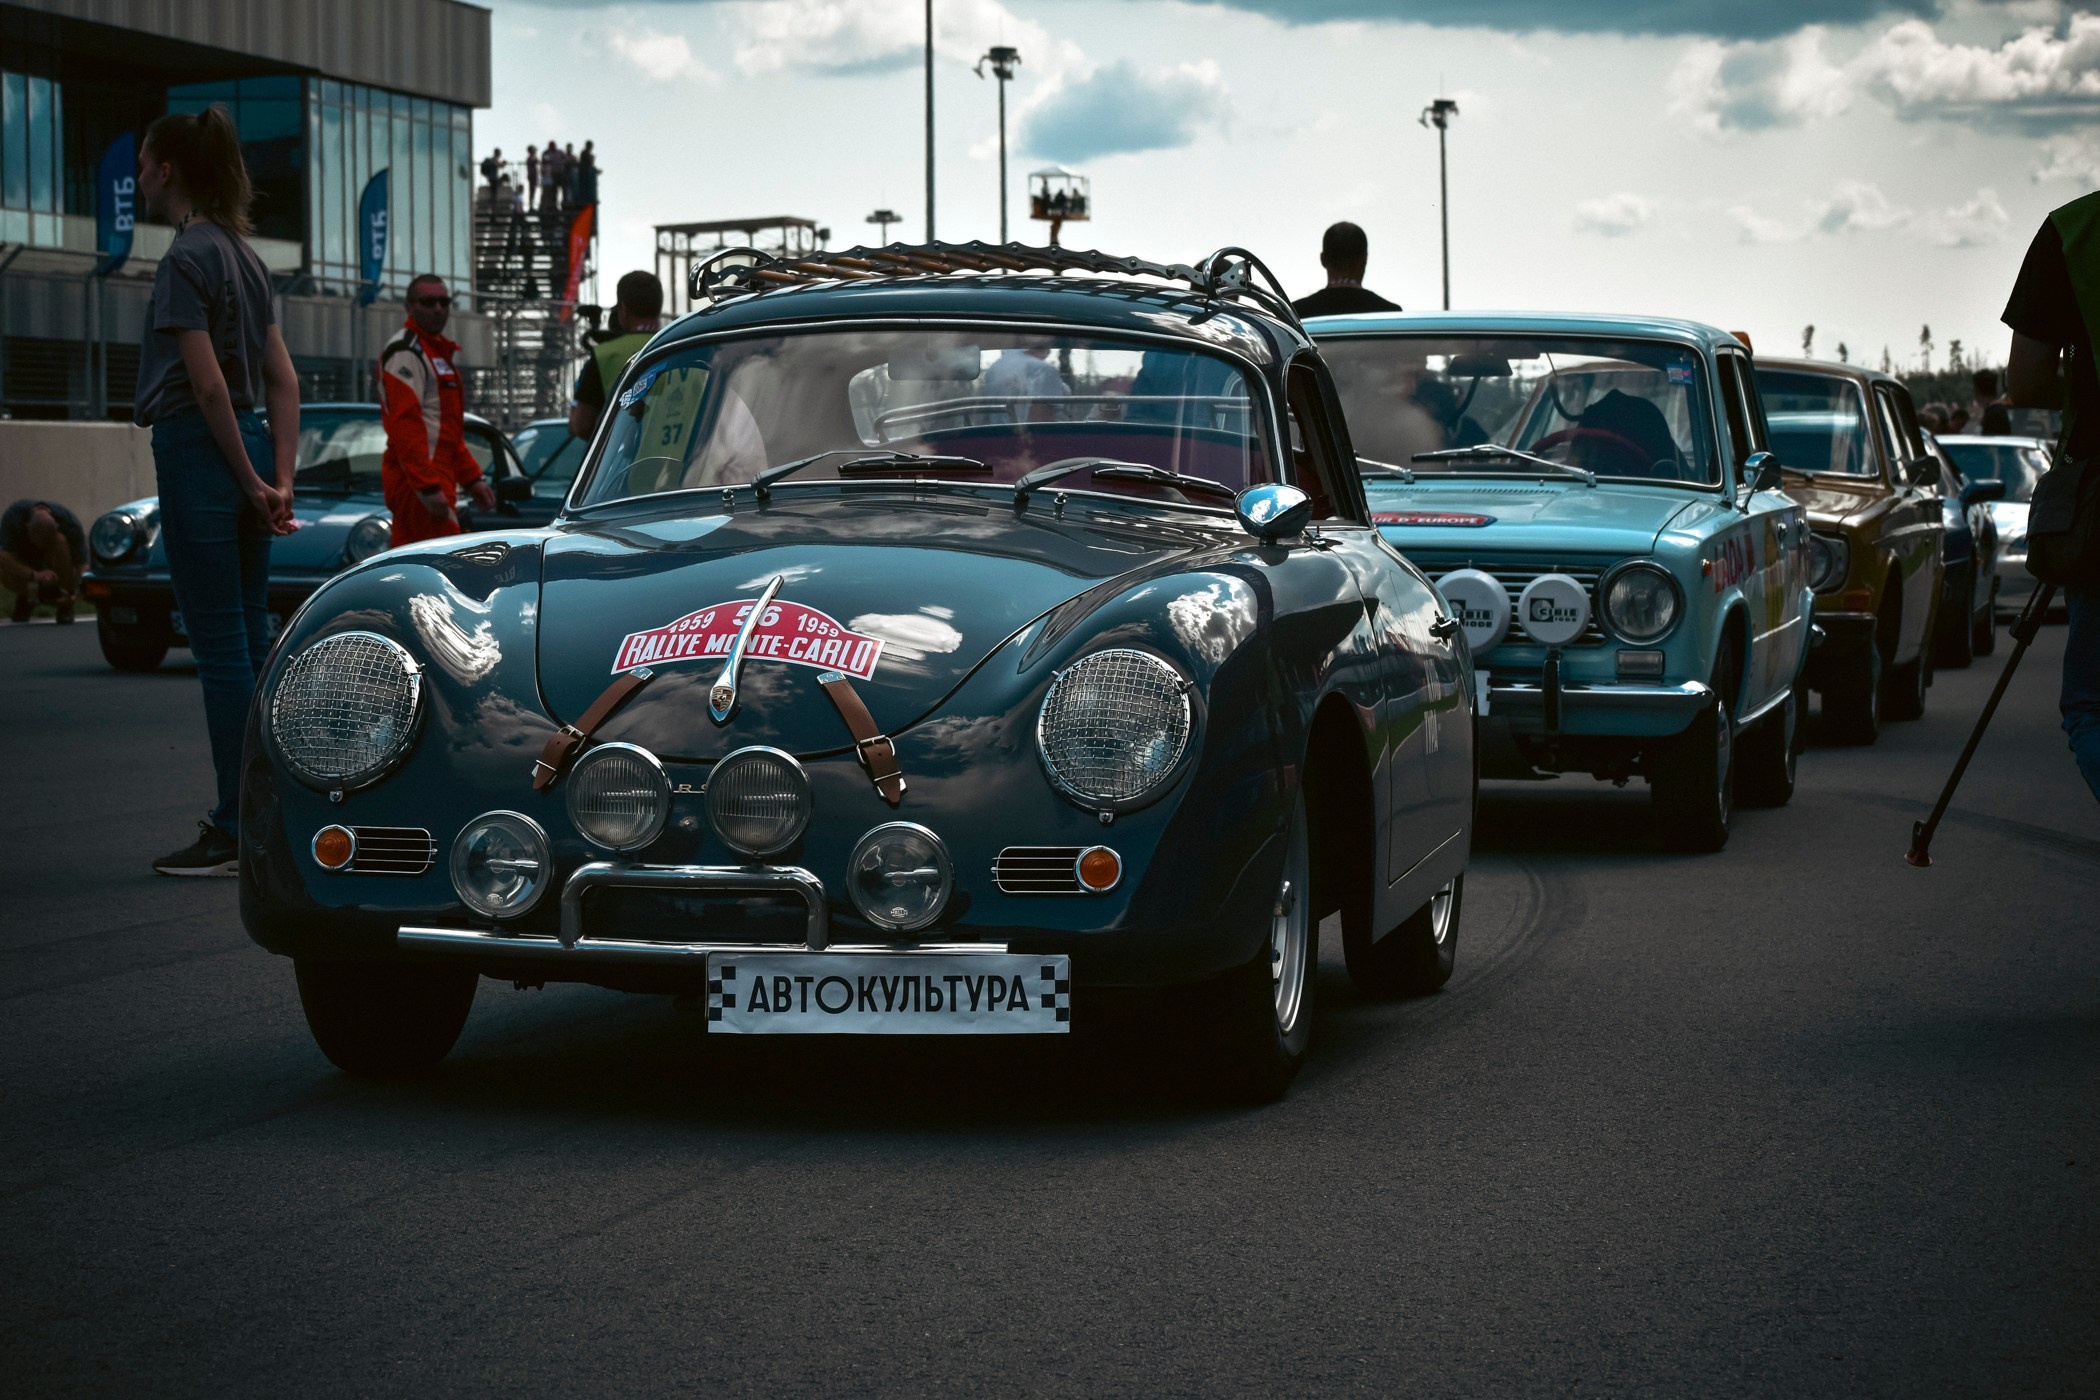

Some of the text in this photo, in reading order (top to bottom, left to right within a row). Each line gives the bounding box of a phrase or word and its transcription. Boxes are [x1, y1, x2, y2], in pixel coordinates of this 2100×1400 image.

[114, 176, 135, 231] ВТБ
[661, 423, 684, 446] 37
[668, 611, 716, 633] 1959
[732, 605, 783, 627] 56
[798, 613, 839, 637] 1959
[623, 633, 703, 666] RALLYE
[746, 974, 1030, 1015] АВТОКУЛЬТУРА
